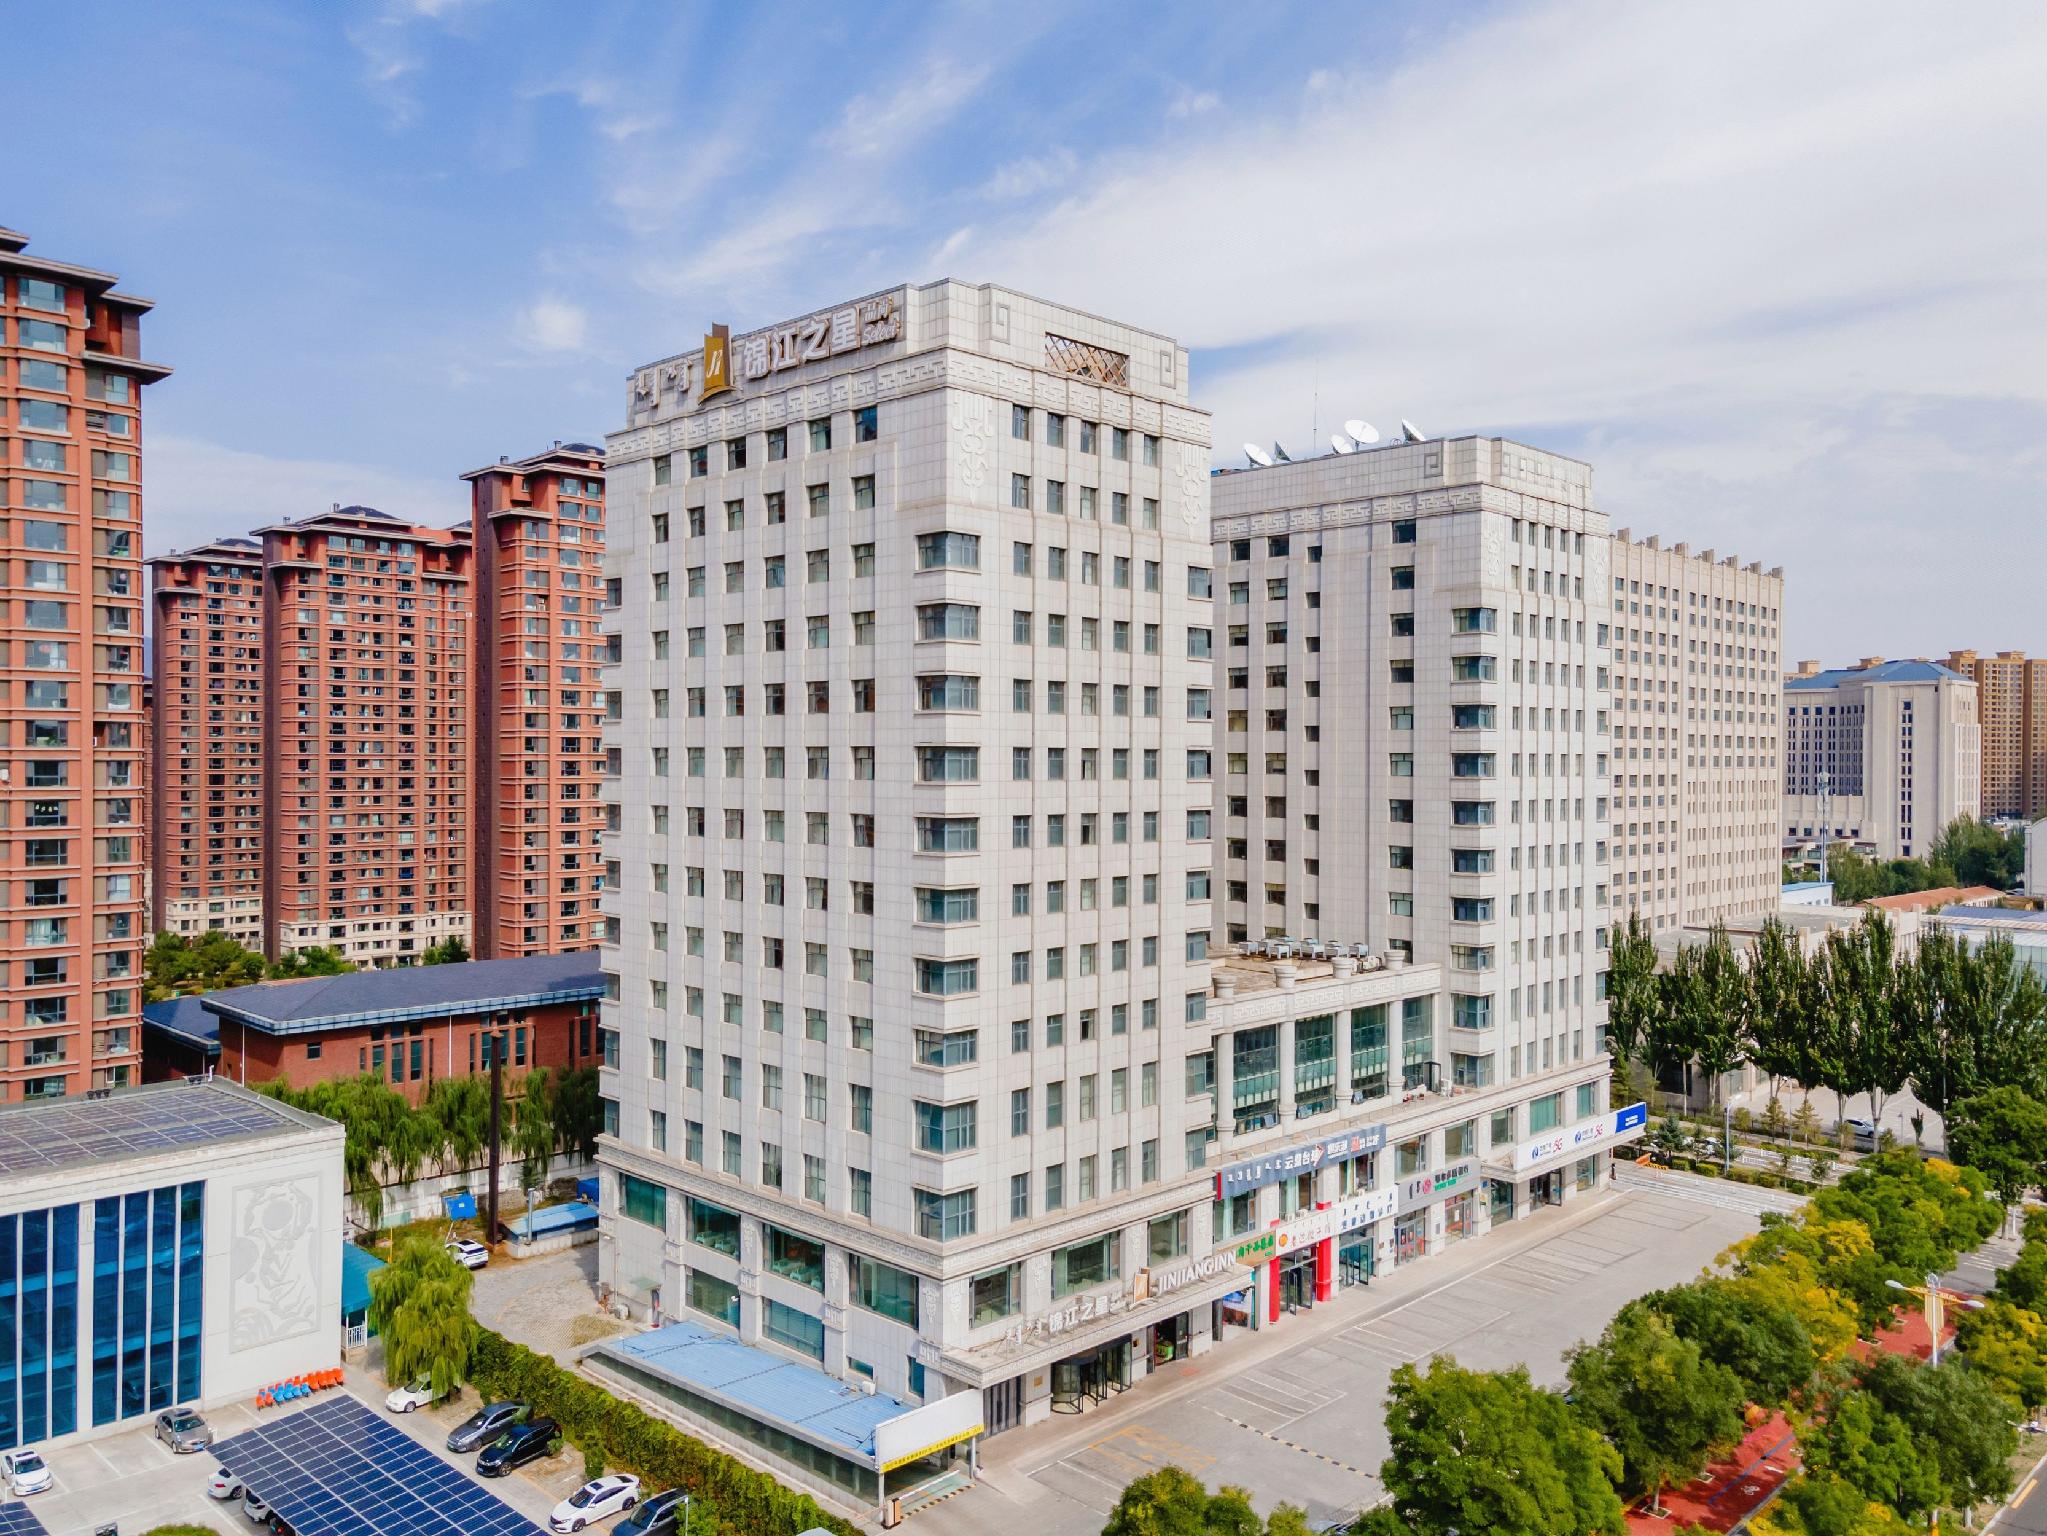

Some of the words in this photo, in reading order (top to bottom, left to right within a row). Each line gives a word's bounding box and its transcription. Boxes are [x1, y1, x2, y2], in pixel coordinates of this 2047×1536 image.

[864, 296, 893, 323] 品尚
[743, 307, 860, 379] 锦江之星
[862, 316, 900, 345] Select
[1049, 1296, 1108, 1333] 锦江之星
